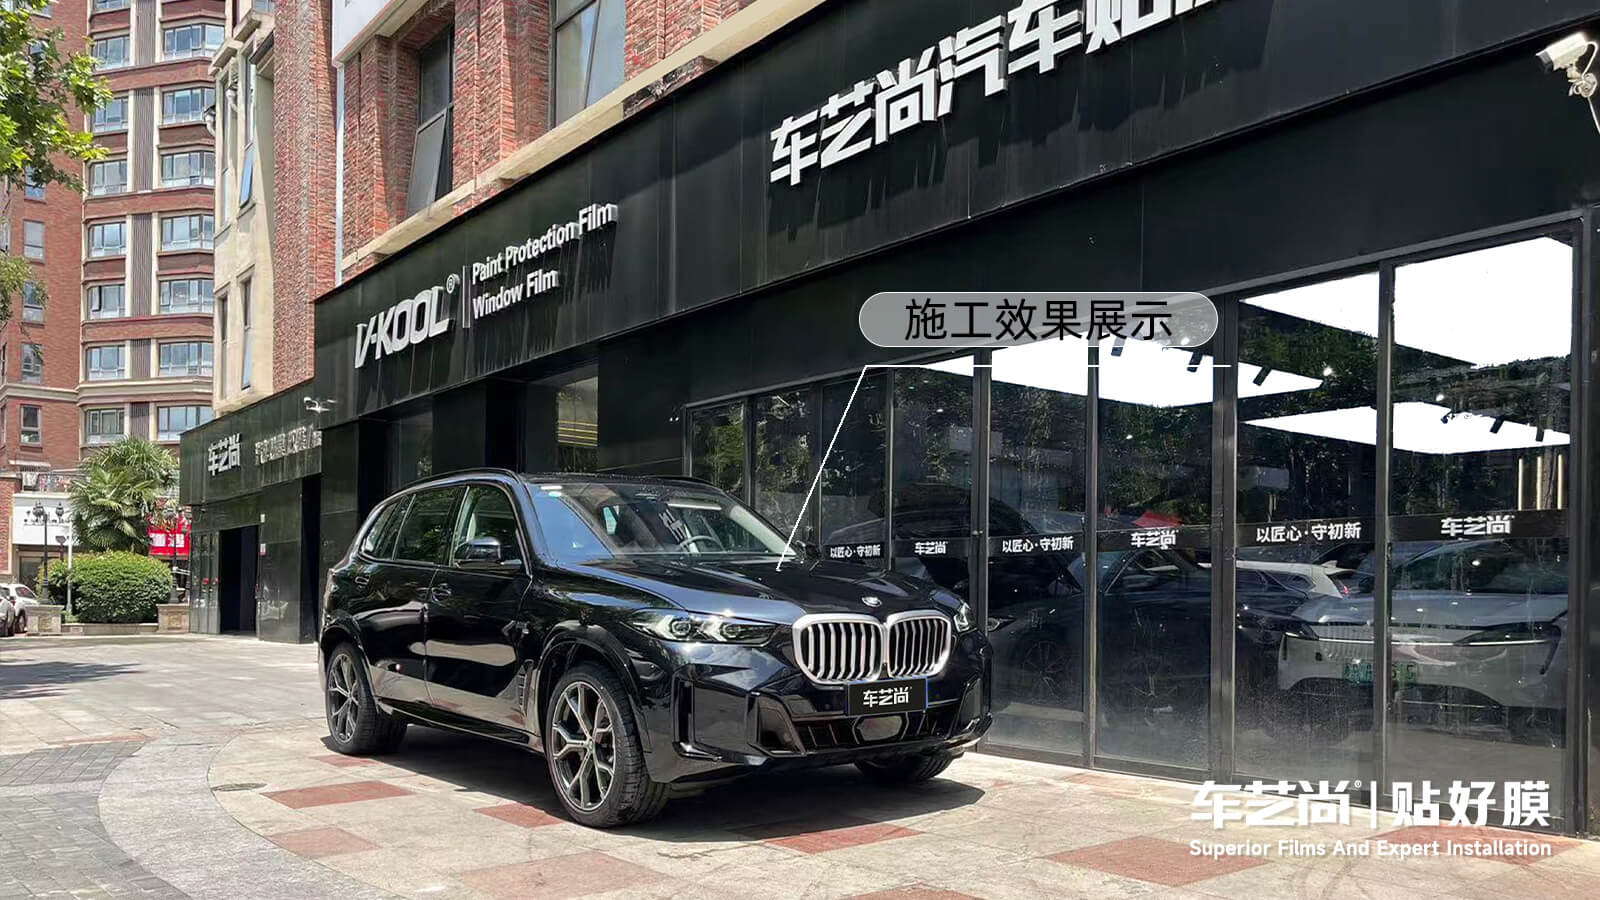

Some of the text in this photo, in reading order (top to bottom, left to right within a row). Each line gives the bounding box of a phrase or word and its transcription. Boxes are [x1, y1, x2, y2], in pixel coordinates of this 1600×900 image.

[770, 0, 1216, 186] 车艺尚汽车贴
[472, 203, 617, 285] Paint Protection Film
[472, 269, 559, 320] Window Film
[207, 432, 240, 477] 车艺尚
[1255, 522, 1362, 543] 以匠心·守初新
[863, 686, 912, 708] 车艺尚
